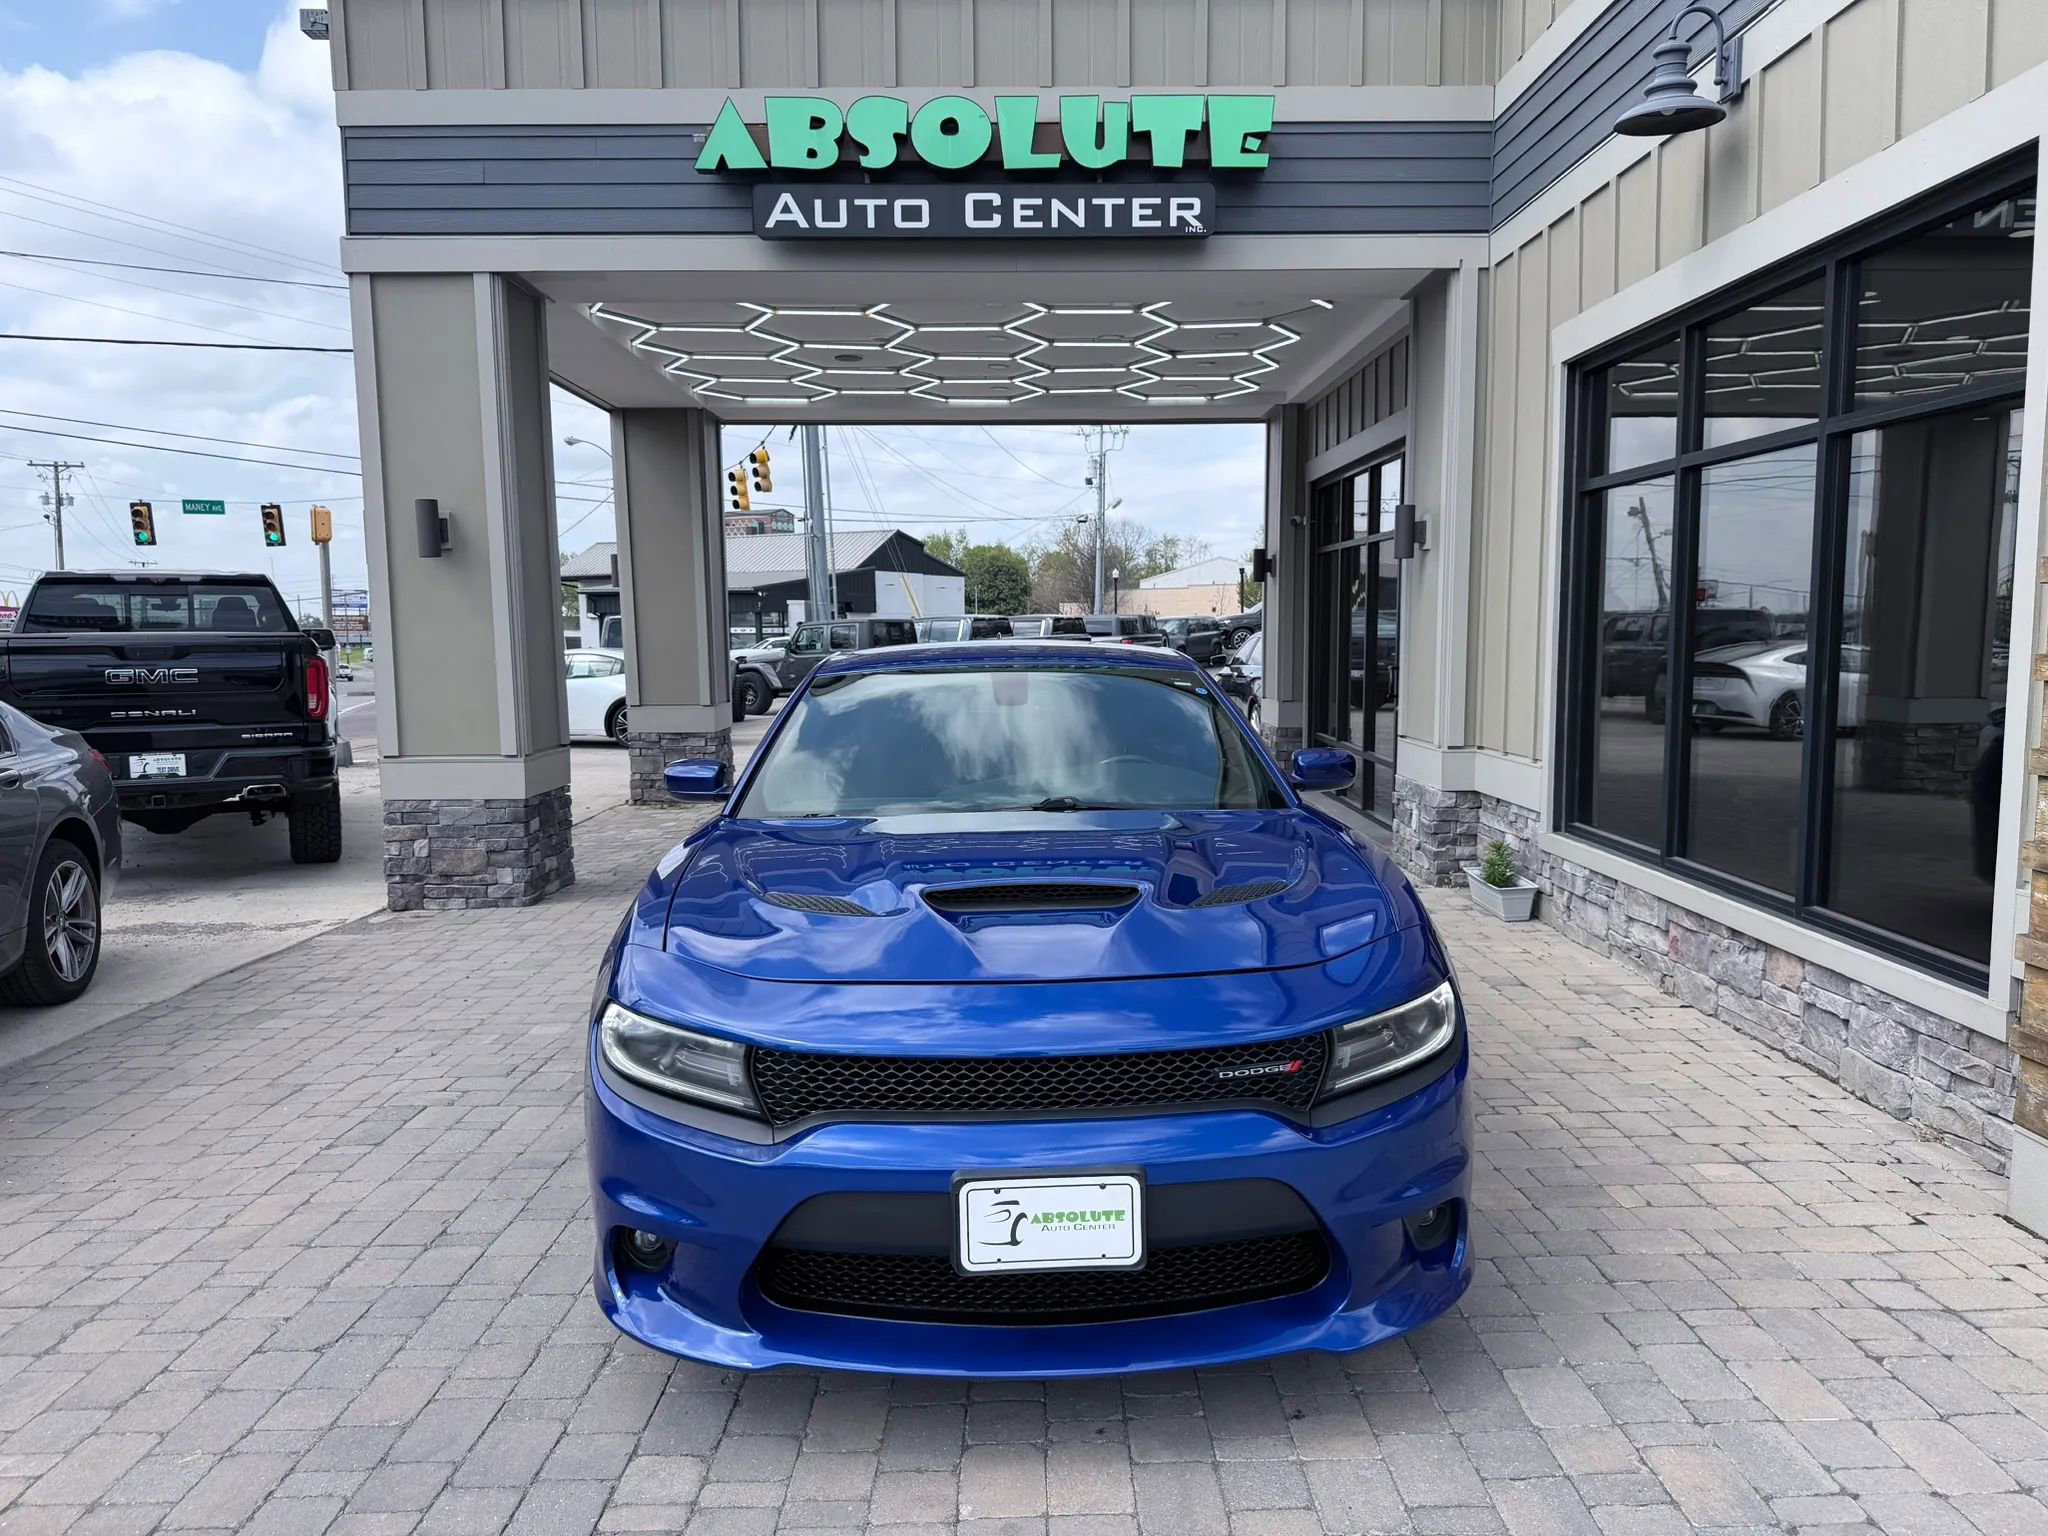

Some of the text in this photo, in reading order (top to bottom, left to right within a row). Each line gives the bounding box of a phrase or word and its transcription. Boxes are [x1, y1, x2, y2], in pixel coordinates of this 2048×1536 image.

[694, 94, 1275, 171] ABSOLUTE
[765, 192, 1203, 228] AUTO CENTER
[1185, 225, 1207, 233] INC.
[185, 503, 210, 512] MANEY
[105, 668, 199, 684] GMC
[110, 709, 197, 718] DENALI
[1218, 1063, 1291, 1079] DODGE
[1030, 1209, 1126, 1225] ABSOLUTE
[1041, 1223, 1116, 1232] AUTO CENTER
